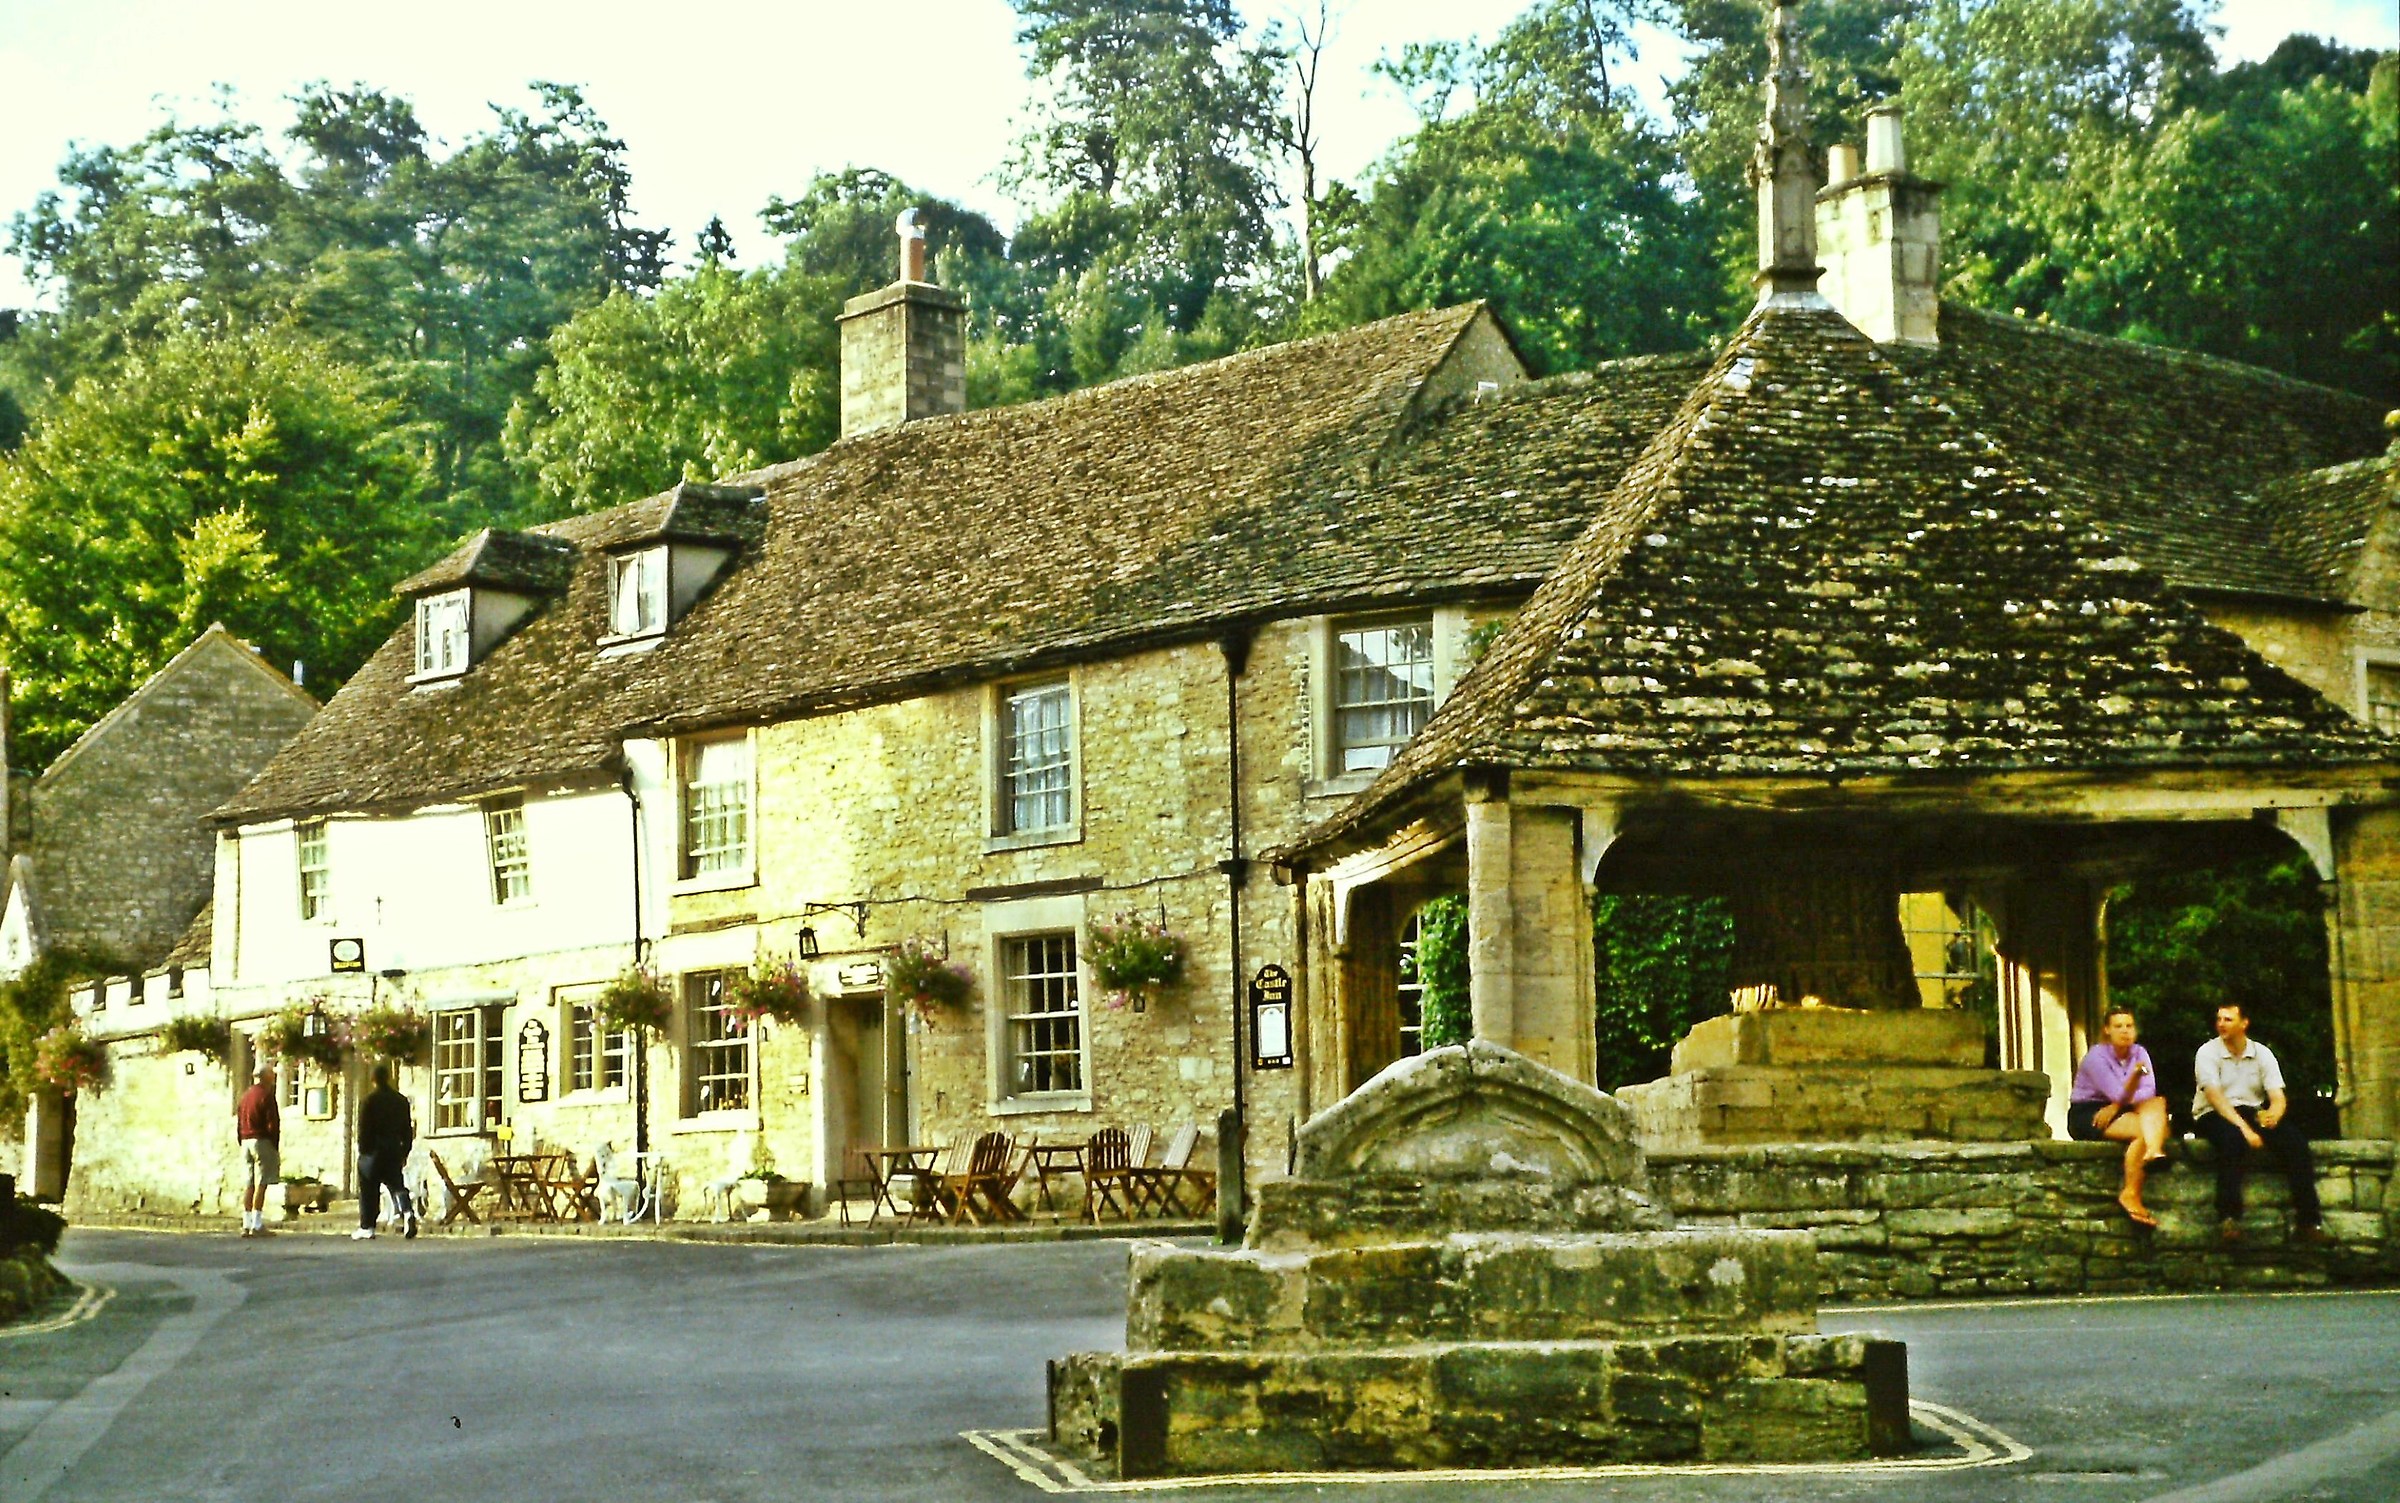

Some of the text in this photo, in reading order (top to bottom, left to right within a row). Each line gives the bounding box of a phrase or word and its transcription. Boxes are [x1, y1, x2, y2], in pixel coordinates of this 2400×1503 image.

[1264, 969, 1278, 978] The
[1255, 977, 1287, 989] Castle
[1263, 990, 1282, 1001] Inn
